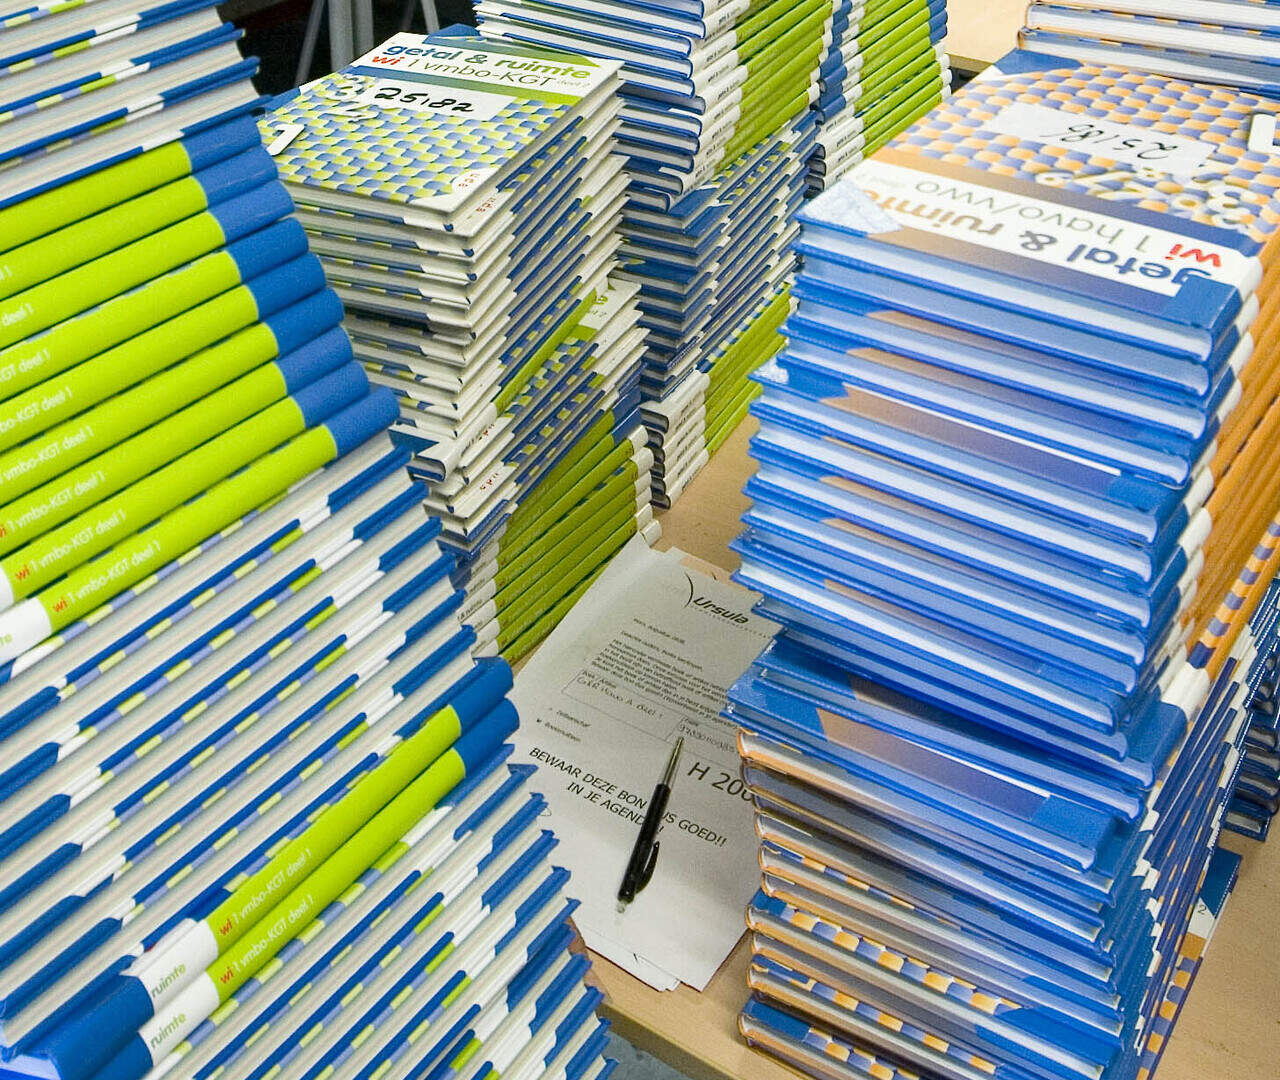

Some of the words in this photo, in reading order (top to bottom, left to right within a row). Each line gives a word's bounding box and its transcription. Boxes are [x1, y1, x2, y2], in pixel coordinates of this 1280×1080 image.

[371, 53, 406, 67] wi
[407, 58, 420, 69] 1
[422, 62, 556, 88] vmbo-KGT
[382, 44, 463, 61] getal
[465, 53, 489, 65] &
[495, 57, 592, 80] ruimte
[373, 86, 475, 114] 25182
[914, 179, 1128, 245] havo/vwo
[1020, 229, 1059, 253] &
[1164, 242, 1223, 268] wi
[6, 265, 13, 278] 1
[1, 306, 26, 327] deel
[28, 302, 36, 316] 1
[18, 354, 44, 374] deel
[43, 348, 51, 362] 1
[41, 390, 67, 412] deel
[66, 385, 74, 399] 1
[4, 443, 62, 483] vmbo-KGT
[62, 430, 88, 451] deel
[87, 424, 95, 438] 1
[8, 518, 17, 533] 1
[16, 490, 74, 531] vmbo-KGT
[73, 477, 99, 498] deel
[98, 470, 106, 485] 1
[15, 564, 31, 581] wi
[30, 559, 39, 574] 1
[38, 528, 95, 570] vmbo-KGT
[95, 514, 120, 536] deel
[119, 508, 127, 523] 1
[52, 597, 69, 613] wi
[68, 591, 76, 606] 1
[75, 560, 131, 601] vmbo-KGT
[130, 547, 155, 568] deel
[154, 540, 162, 555] 1
[693, 596, 750, 625] Ursula
[688, 761, 711, 781] H
[529, 747, 583, 779] BEWAAR
[582, 773, 617, 795] DEZE
[617, 790, 648, 810] BON
[677, 819, 728, 848] GOED!!
[567, 781, 585, 796] IN
[584, 787, 601, 803] JE
[151, 963, 187, 999] ruimte
[219, 916, 234, 936] wi
[233, 911, 240, 925] 1
[238, 871, 286, 924] vmbo-KGT
[286, 855, 307, 877] deel
[305, 847, 314, 862] 1
[150, 1012, 187, 1050] ruimte
[219, 965, 235, 985] wi
[233, 960, 241, 974] 1
[239, 918, 289, 971] vmbo-KGT
[288, 902, 308, 926] deel
[306, 894, 314, 909] 1
